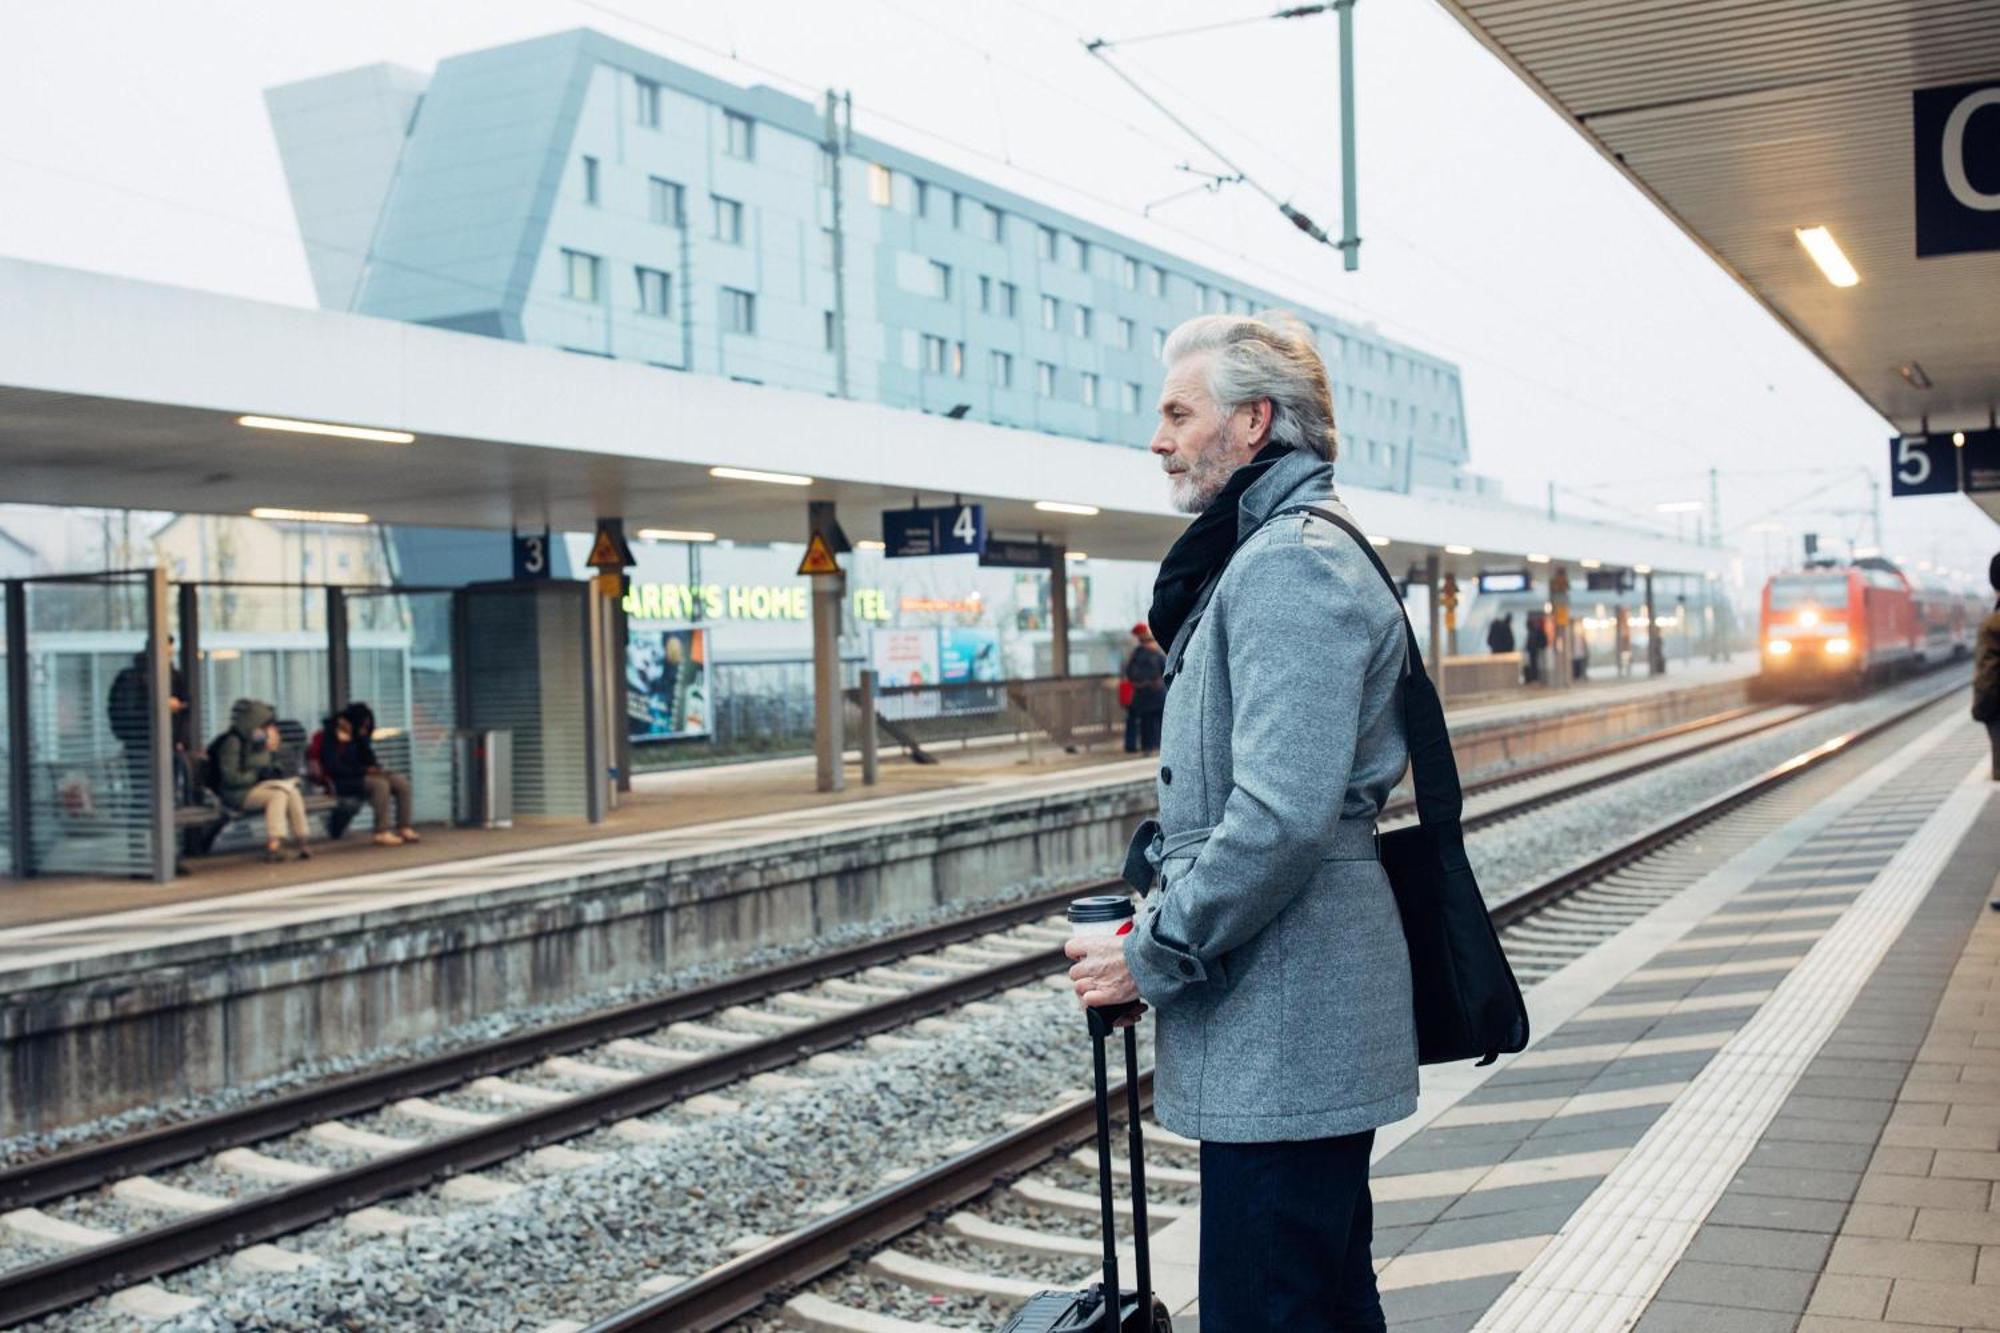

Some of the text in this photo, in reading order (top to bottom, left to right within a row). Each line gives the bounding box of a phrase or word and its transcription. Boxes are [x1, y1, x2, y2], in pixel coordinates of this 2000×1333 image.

[1898, 436, 1931, 485] 5
[952, 506, 976, 545] 4
[525, 539, 544, 572] 3
[622, 583, 723, 620] ARRY'S
[728, 586, 808, 620] HOME
